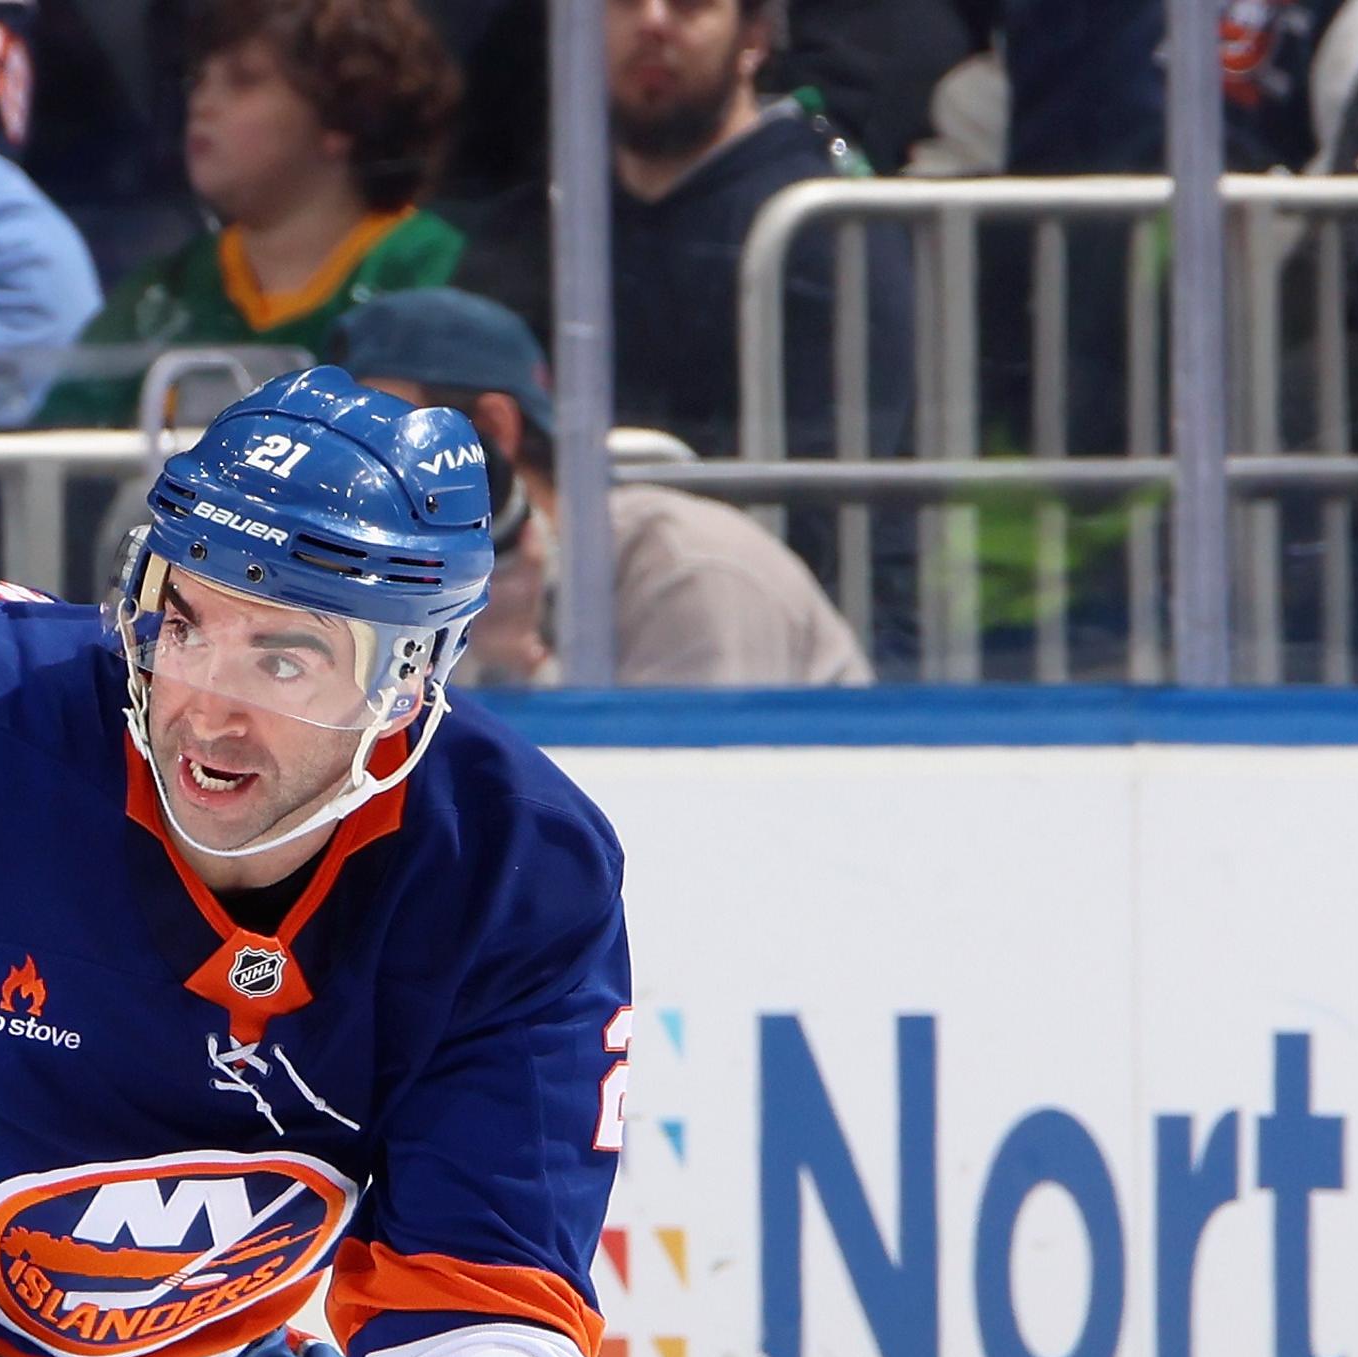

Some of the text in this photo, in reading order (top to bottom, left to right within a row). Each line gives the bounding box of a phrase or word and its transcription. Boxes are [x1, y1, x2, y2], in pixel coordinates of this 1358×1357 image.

[245, 434, 310, 479] 21
[239, 962, 274, 984] NHL
[8, 1016, 81, 1049] stove
[8, 1255, 285, 1341] ISLANDERS
